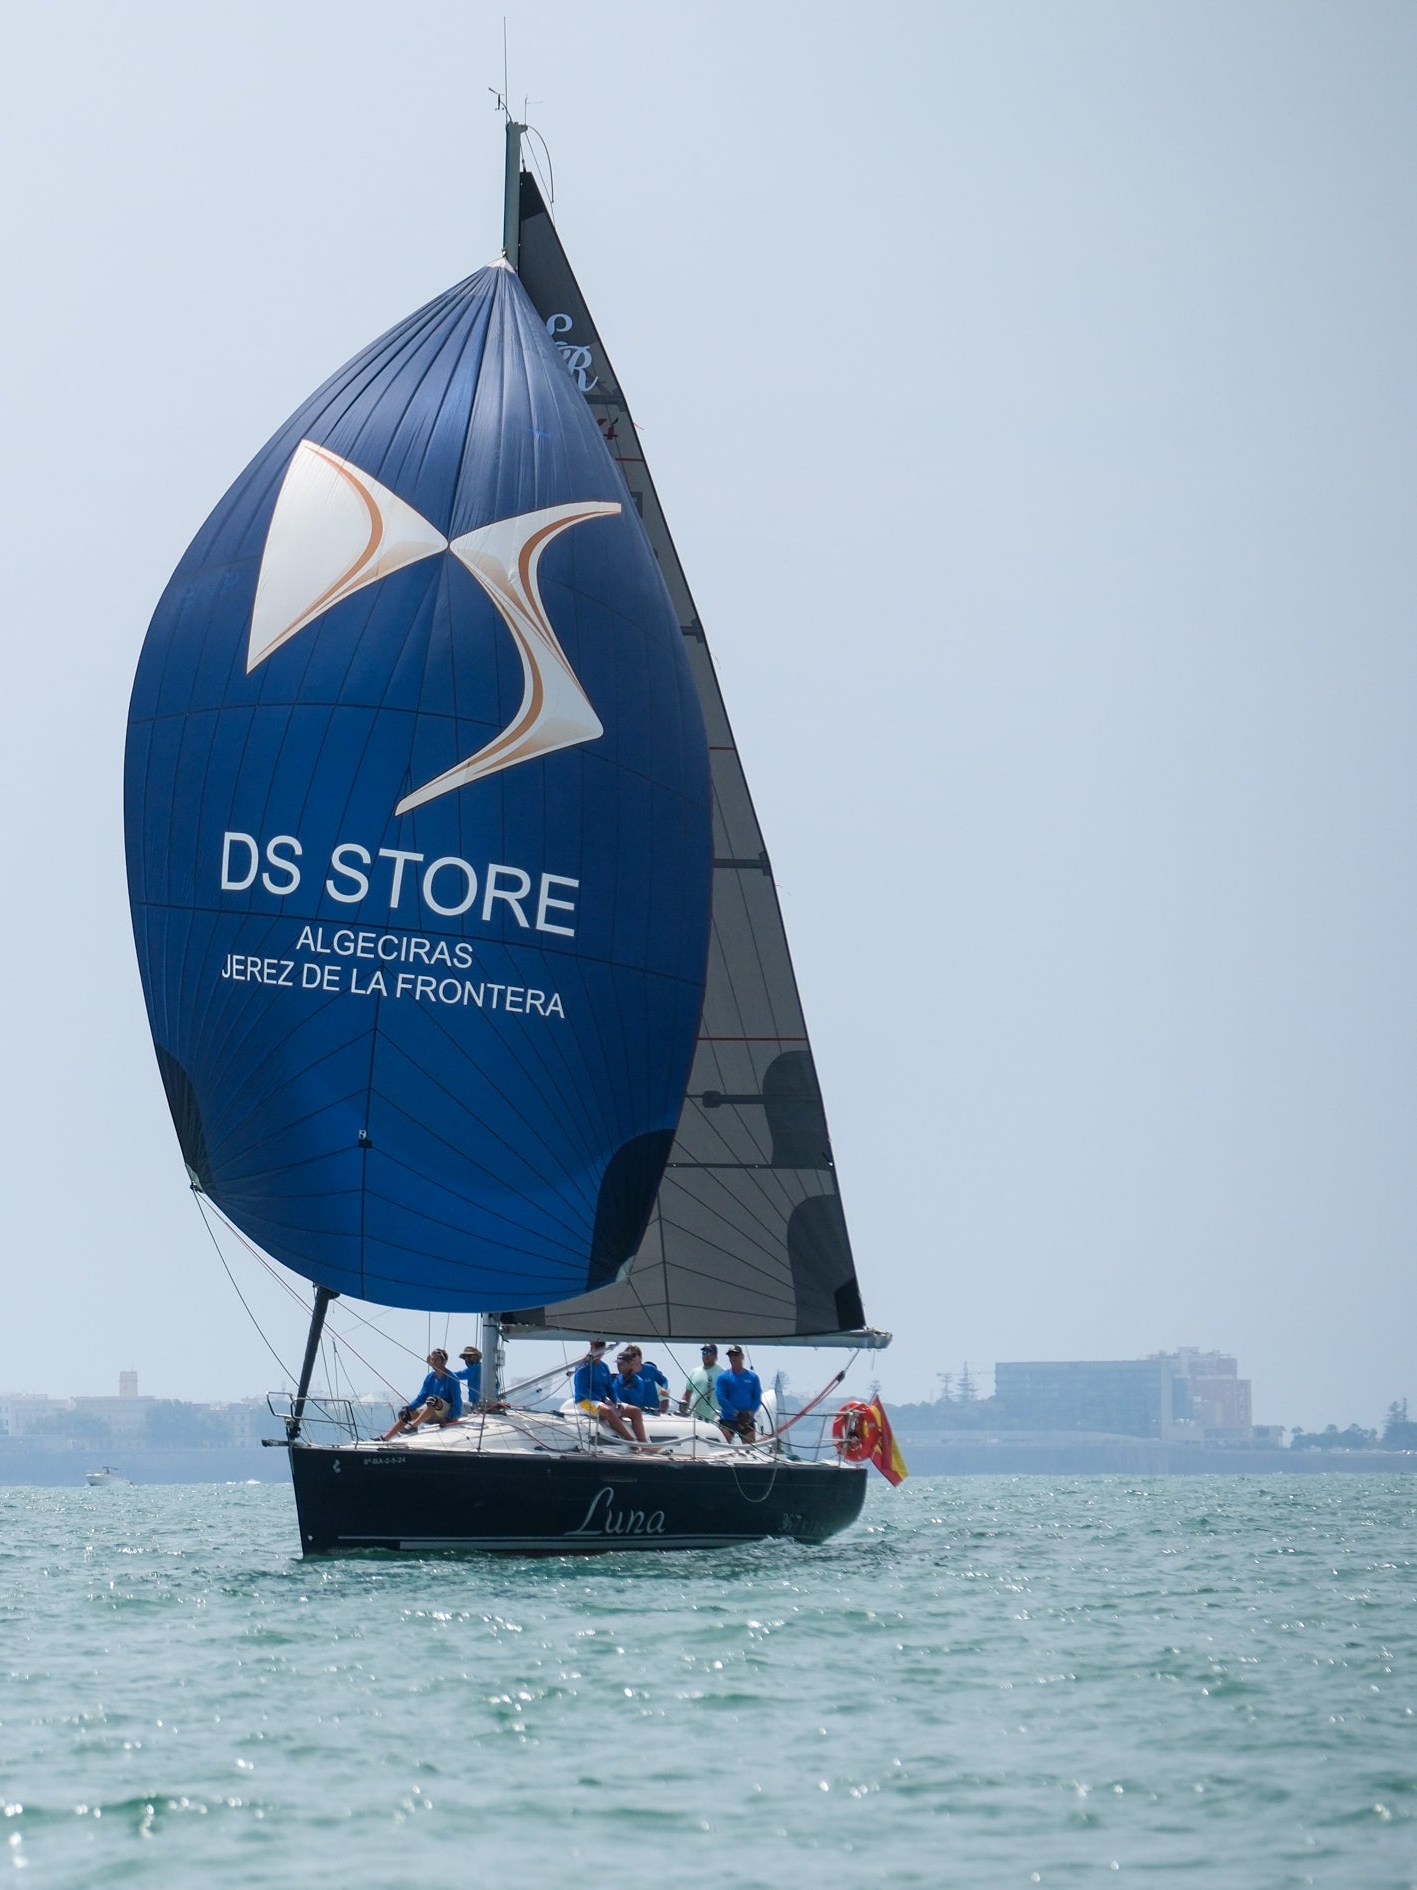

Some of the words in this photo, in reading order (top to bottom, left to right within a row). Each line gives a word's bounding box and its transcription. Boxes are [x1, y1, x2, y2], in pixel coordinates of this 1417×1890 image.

[220, 831, 303, 896] DS
[325, 843, 581, 938] STORE
[296, 926, 474, 969] ALGECIRAS
[221, 954, 295, 987] JEREZ
[301, 963, 341, 992] DE
[350, 968, 388, 996] LA
[395, 973, 566, 1019] FRONTERA
[563, 1486, 666, 1536] Luna
